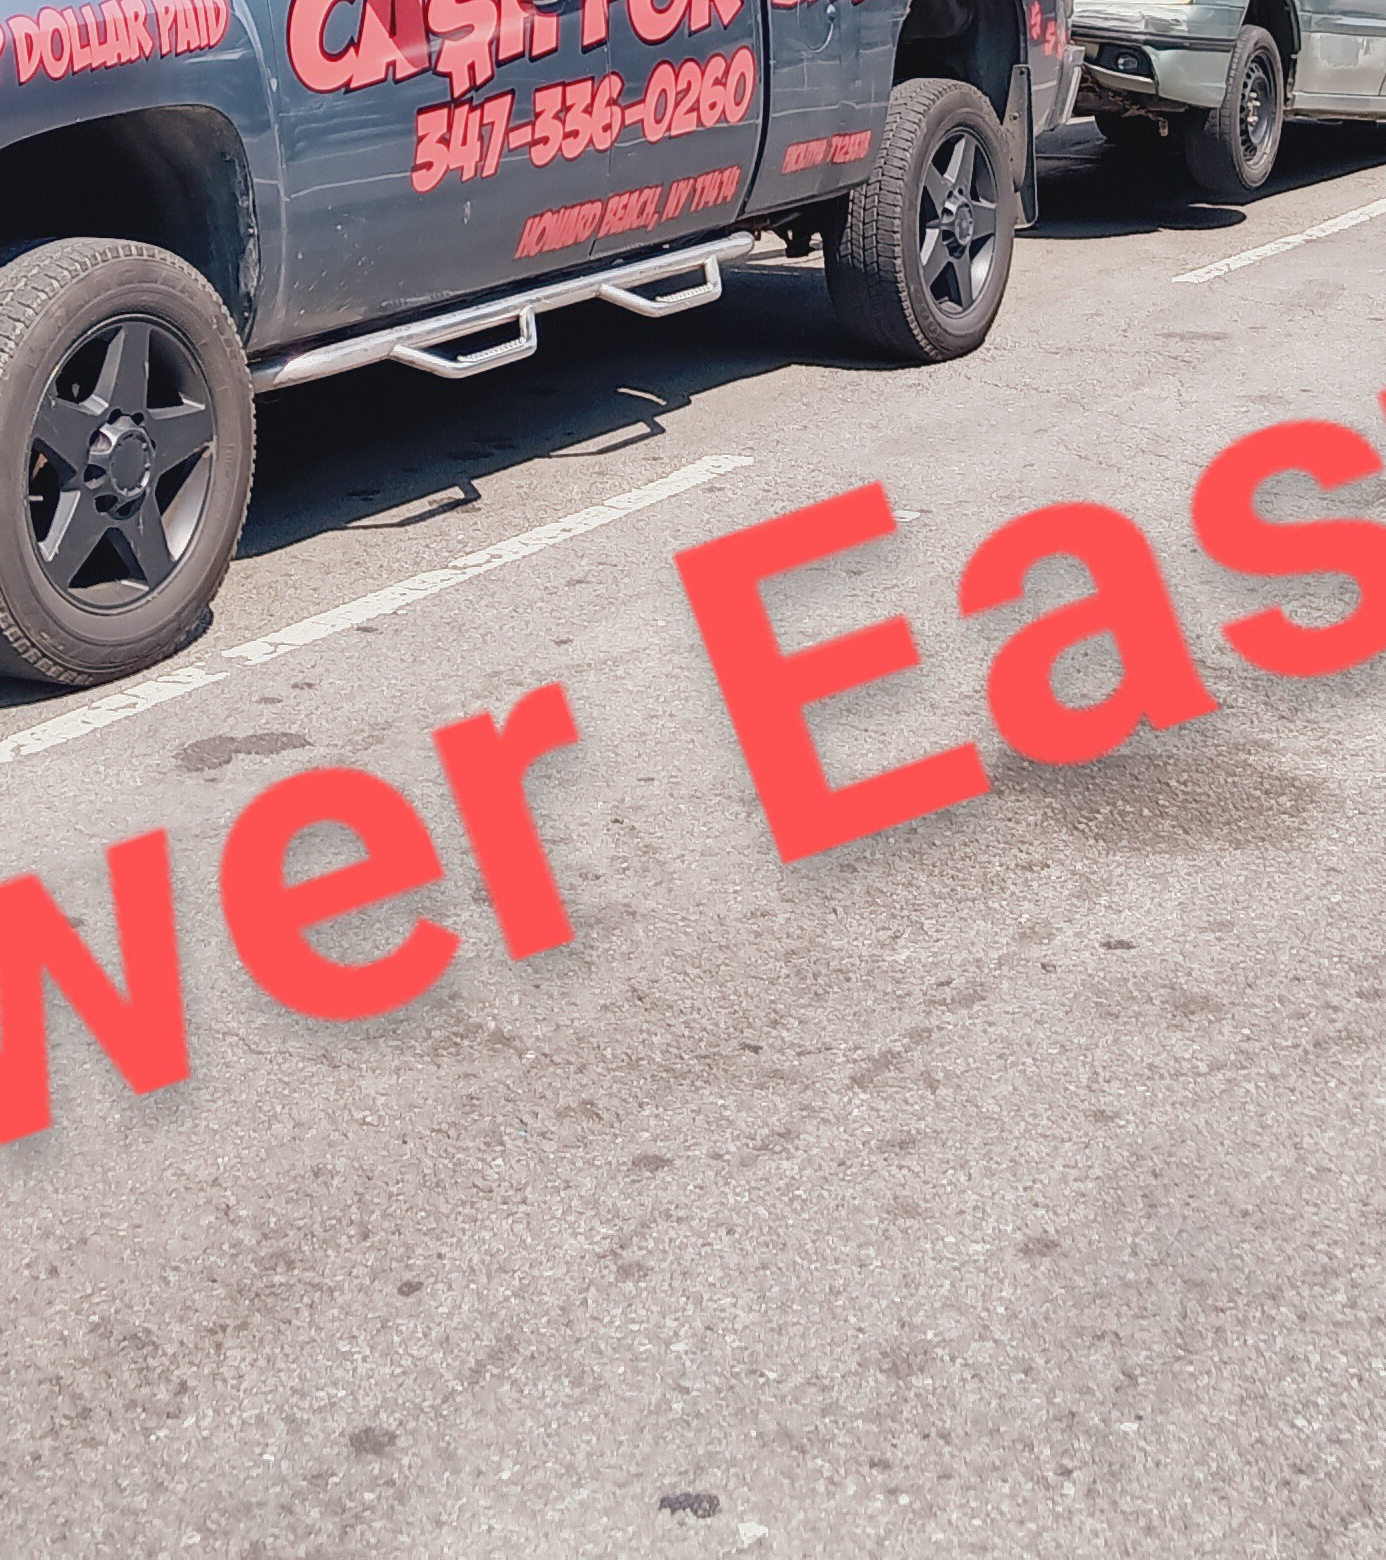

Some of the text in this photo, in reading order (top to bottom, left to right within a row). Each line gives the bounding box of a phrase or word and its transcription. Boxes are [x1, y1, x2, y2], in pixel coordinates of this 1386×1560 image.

[411, 45, 757, 193] 347-336-0260
[514, 199, 603, 260] HOWARD
[661, 177, 693, 224] NY
